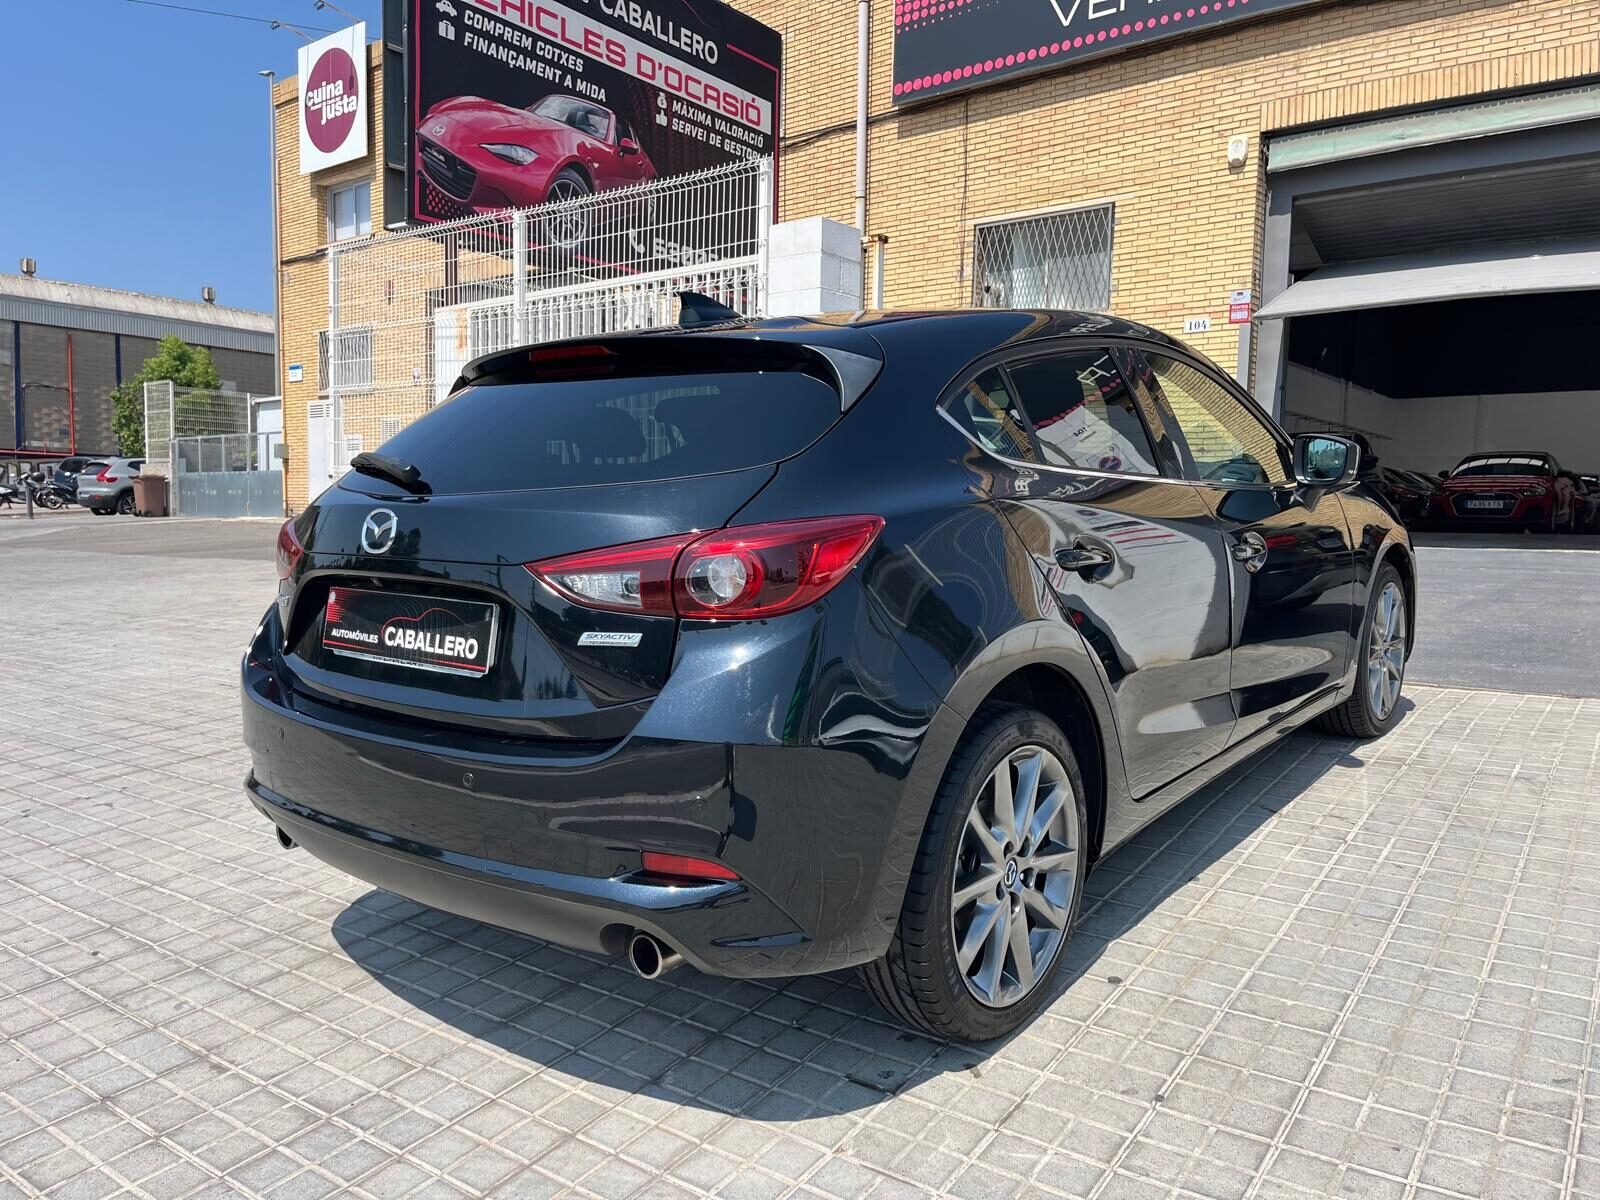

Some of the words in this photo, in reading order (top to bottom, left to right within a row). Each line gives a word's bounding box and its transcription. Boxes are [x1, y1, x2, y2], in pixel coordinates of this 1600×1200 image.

[464, 9, 532, 51] COMPREM
[536, 40, 584, 73] COTXES
[599, 0, 718, 65] CABALLERO
[464, 31, 562, 84] FINANÇAMENT
[563, 74, 573, 89] A
[576, 78, 606, 102] MIDA
[306, 79, 344, 107] cuina
[321, 94, 358, 126] justa
[672, 100, 712, 127] MÀXIMA
[715, 117, 764, 148] VALORACIÓ
[672, 118, 706, 142] SERVEI
[709, 132, 722, 148] DE
[1189, 320, 1207, 331] 104
[331, 628, 379, 643] AUTOMÓVILES
[384, 626, 479, 660] CABALLERO
